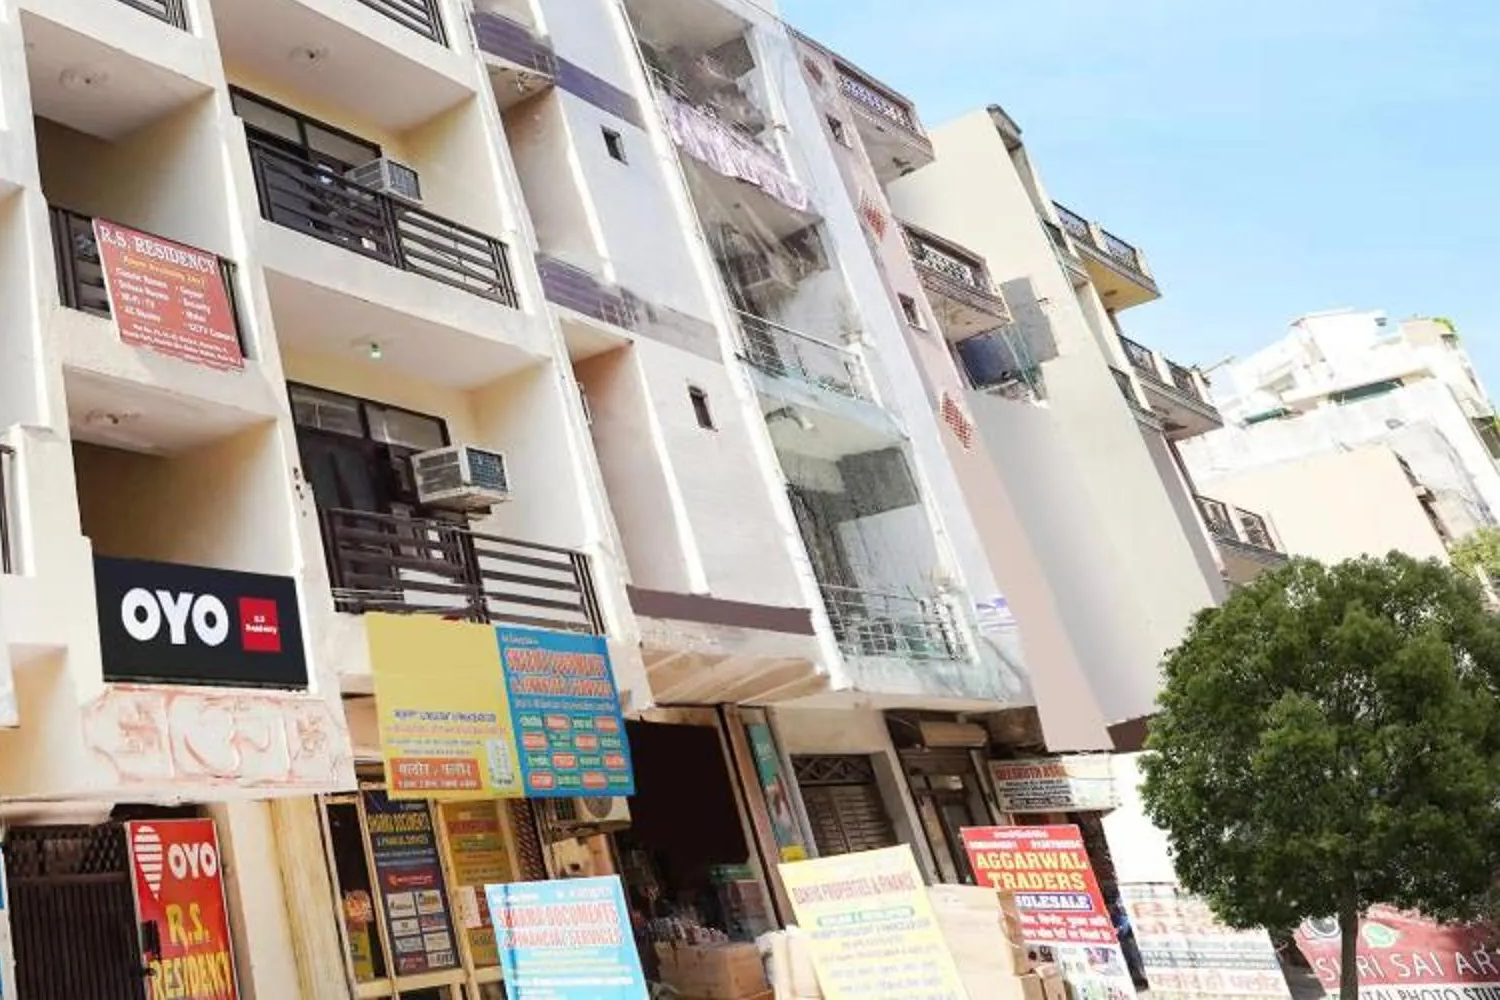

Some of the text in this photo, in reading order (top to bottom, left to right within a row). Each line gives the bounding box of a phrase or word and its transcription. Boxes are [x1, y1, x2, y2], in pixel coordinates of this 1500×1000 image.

[100, 226, 217, 275] R.S. RESIDENCY
[121, 587, 229, 647] OYO
[167, 842, 218, 880] OYO
[976, 851, 1090, 870] AGGARWAL
[988, 871, 1087, 890] TRADERS
[545, 901, 620, 927] DOCUMENTS
[1016, 894, 1091, 910] OLESALE
[166, 903, 211, 954] R.S.
[150, 953, 233, 1000] RESIDENCY
[1390, 951, 1444, 977] SAI
